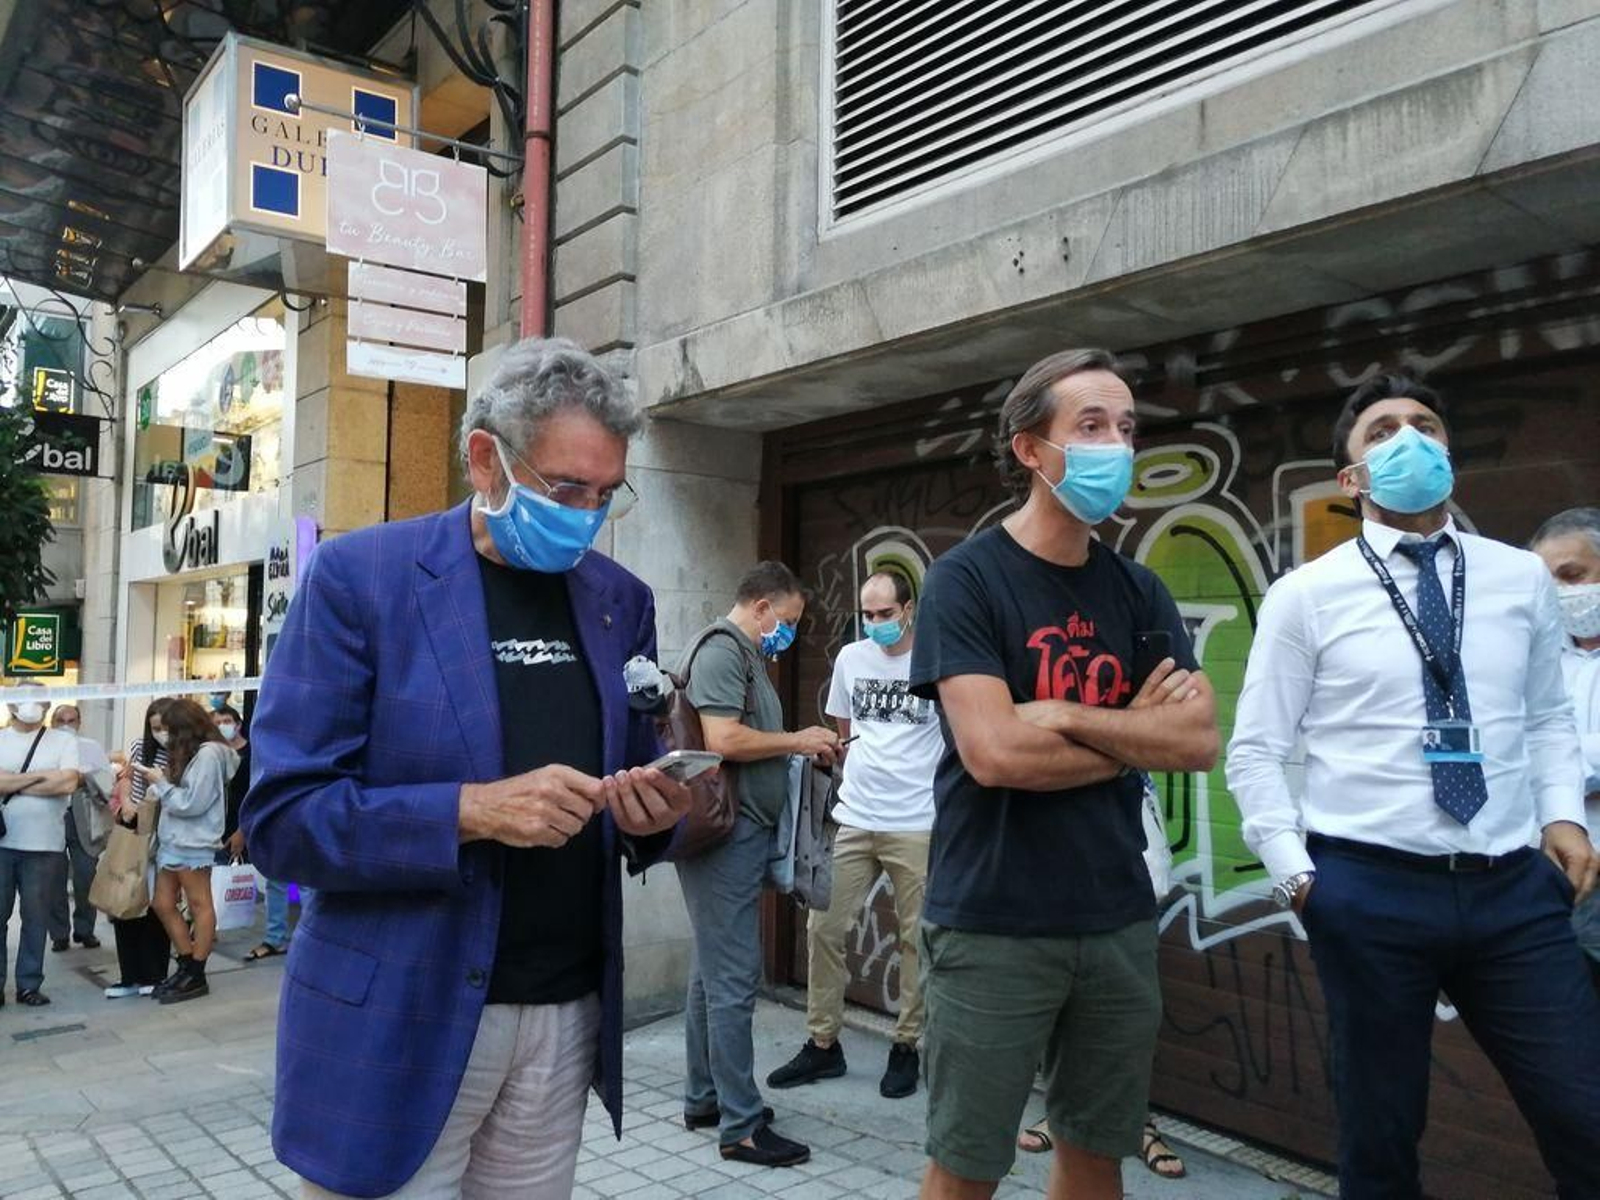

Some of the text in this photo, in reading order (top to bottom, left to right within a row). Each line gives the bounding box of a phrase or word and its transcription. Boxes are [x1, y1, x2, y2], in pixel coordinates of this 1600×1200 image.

[367, 223, 430, 255] Beauty
[27, 625, 52, 636] Casa
[39, 634, 52, 643] del
[26, 640, 52, 651] Libro
